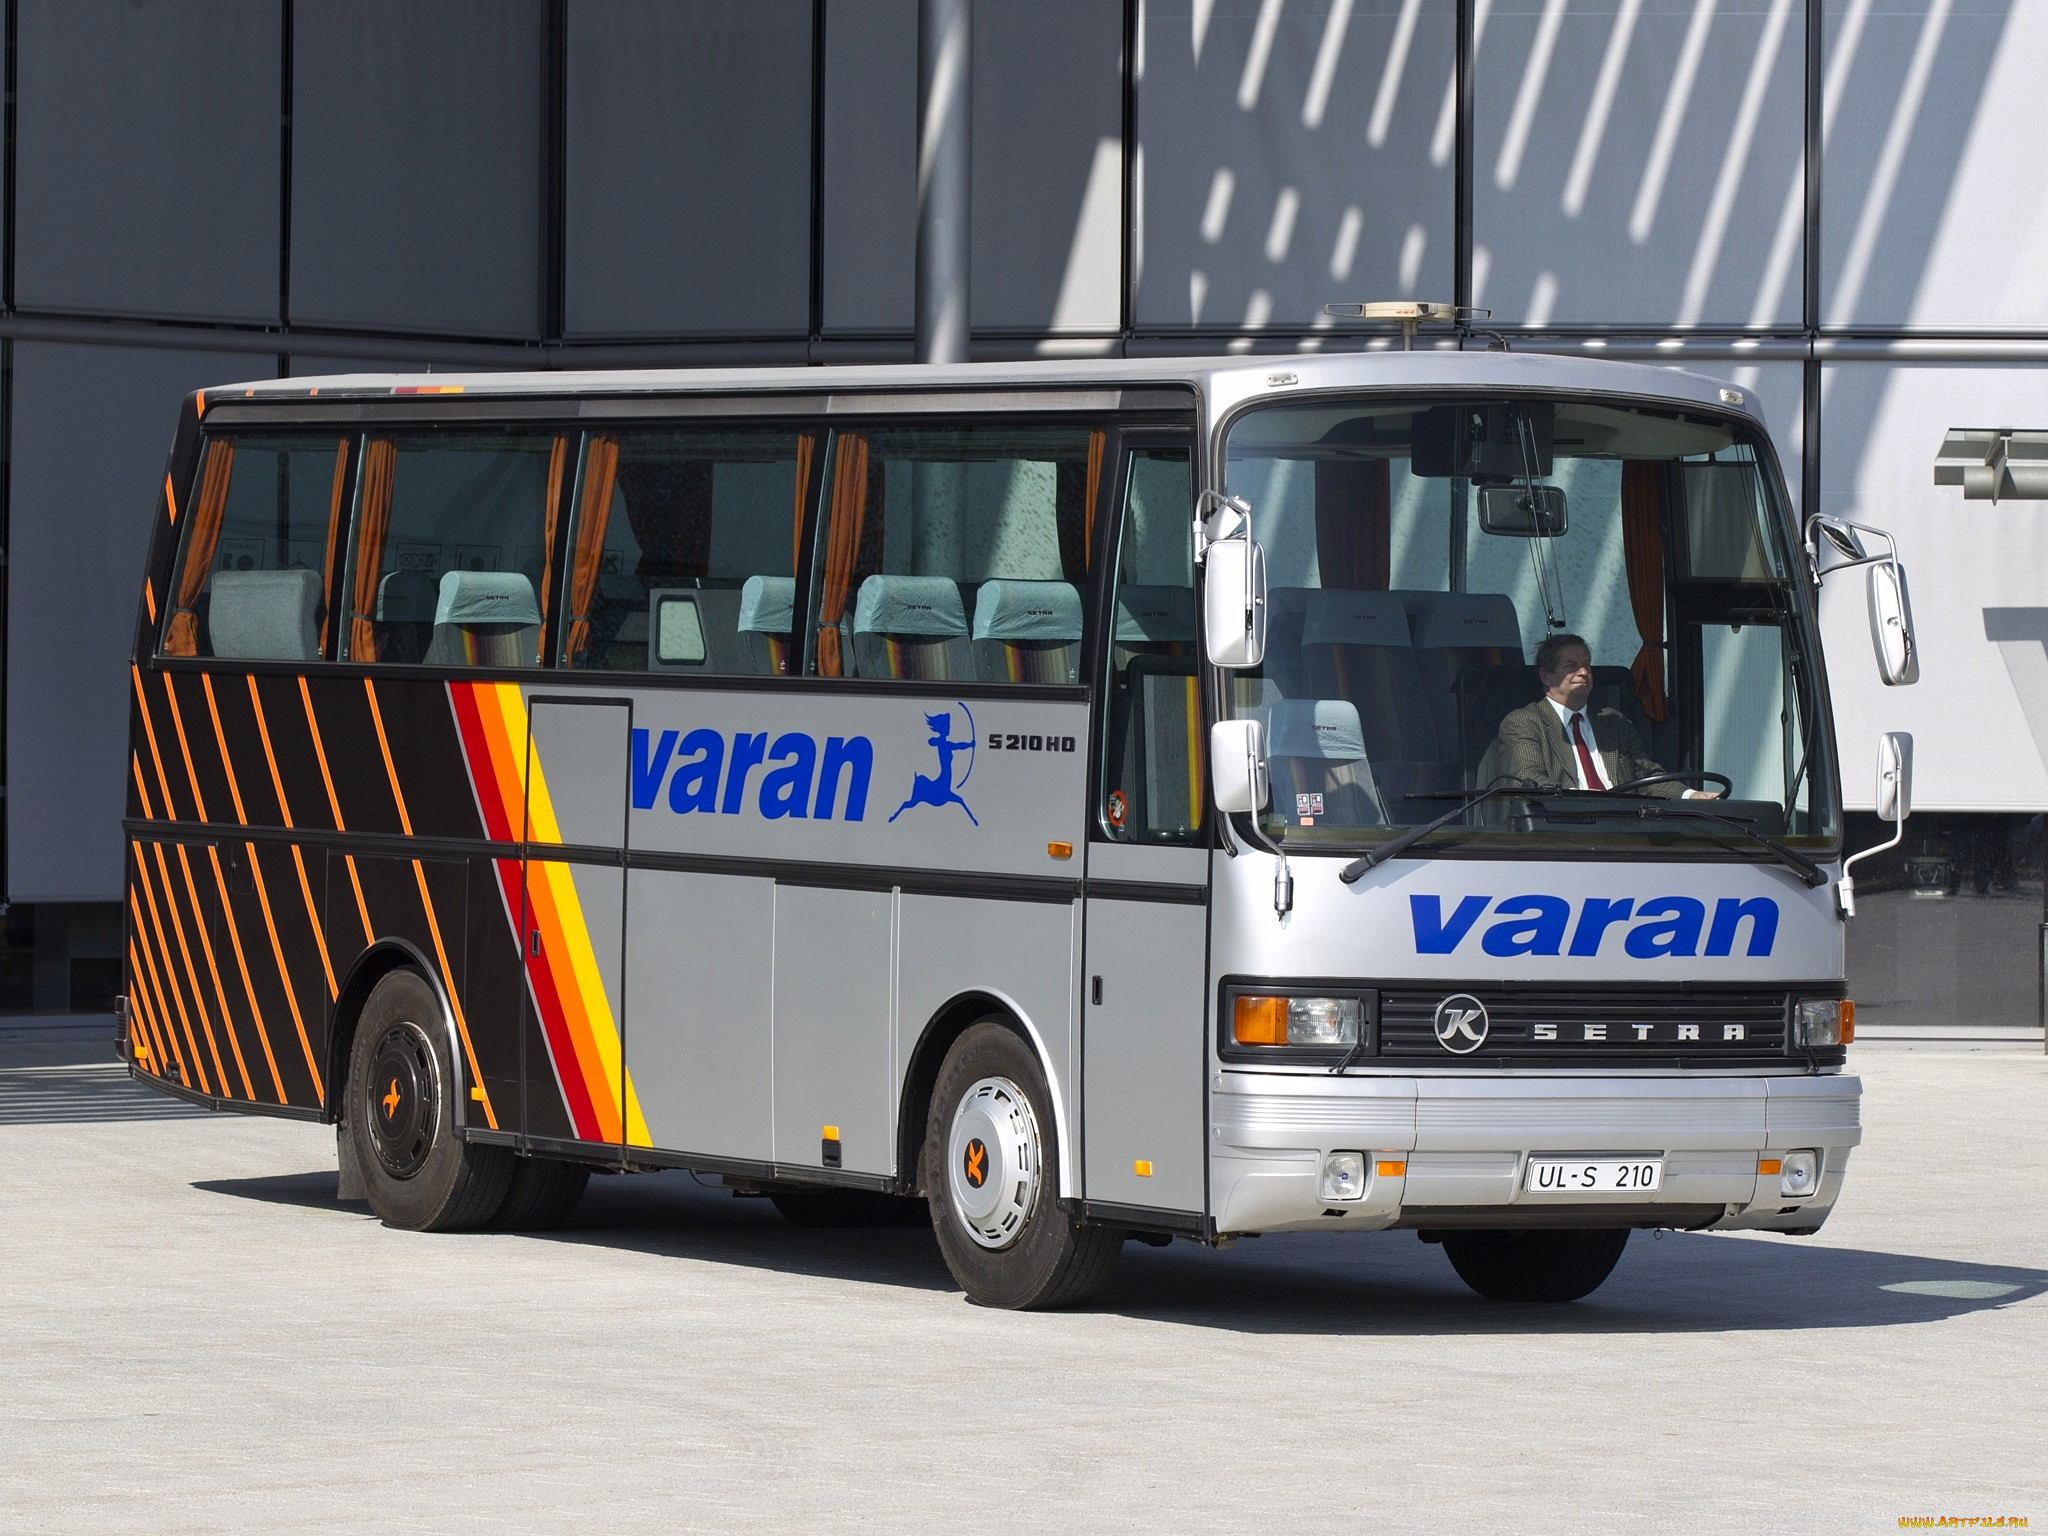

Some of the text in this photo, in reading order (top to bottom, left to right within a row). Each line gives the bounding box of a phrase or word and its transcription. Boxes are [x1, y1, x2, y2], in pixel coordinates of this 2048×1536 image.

[988, 733, 1075, 752] S 210 HD
[632, 728, 874, 822] varan
[1409, 894, 1779, 959] varan
[1534, 1023, 1745, 1041] SETRA
[1538, 1164, 1654, 1188] UL-S 210
